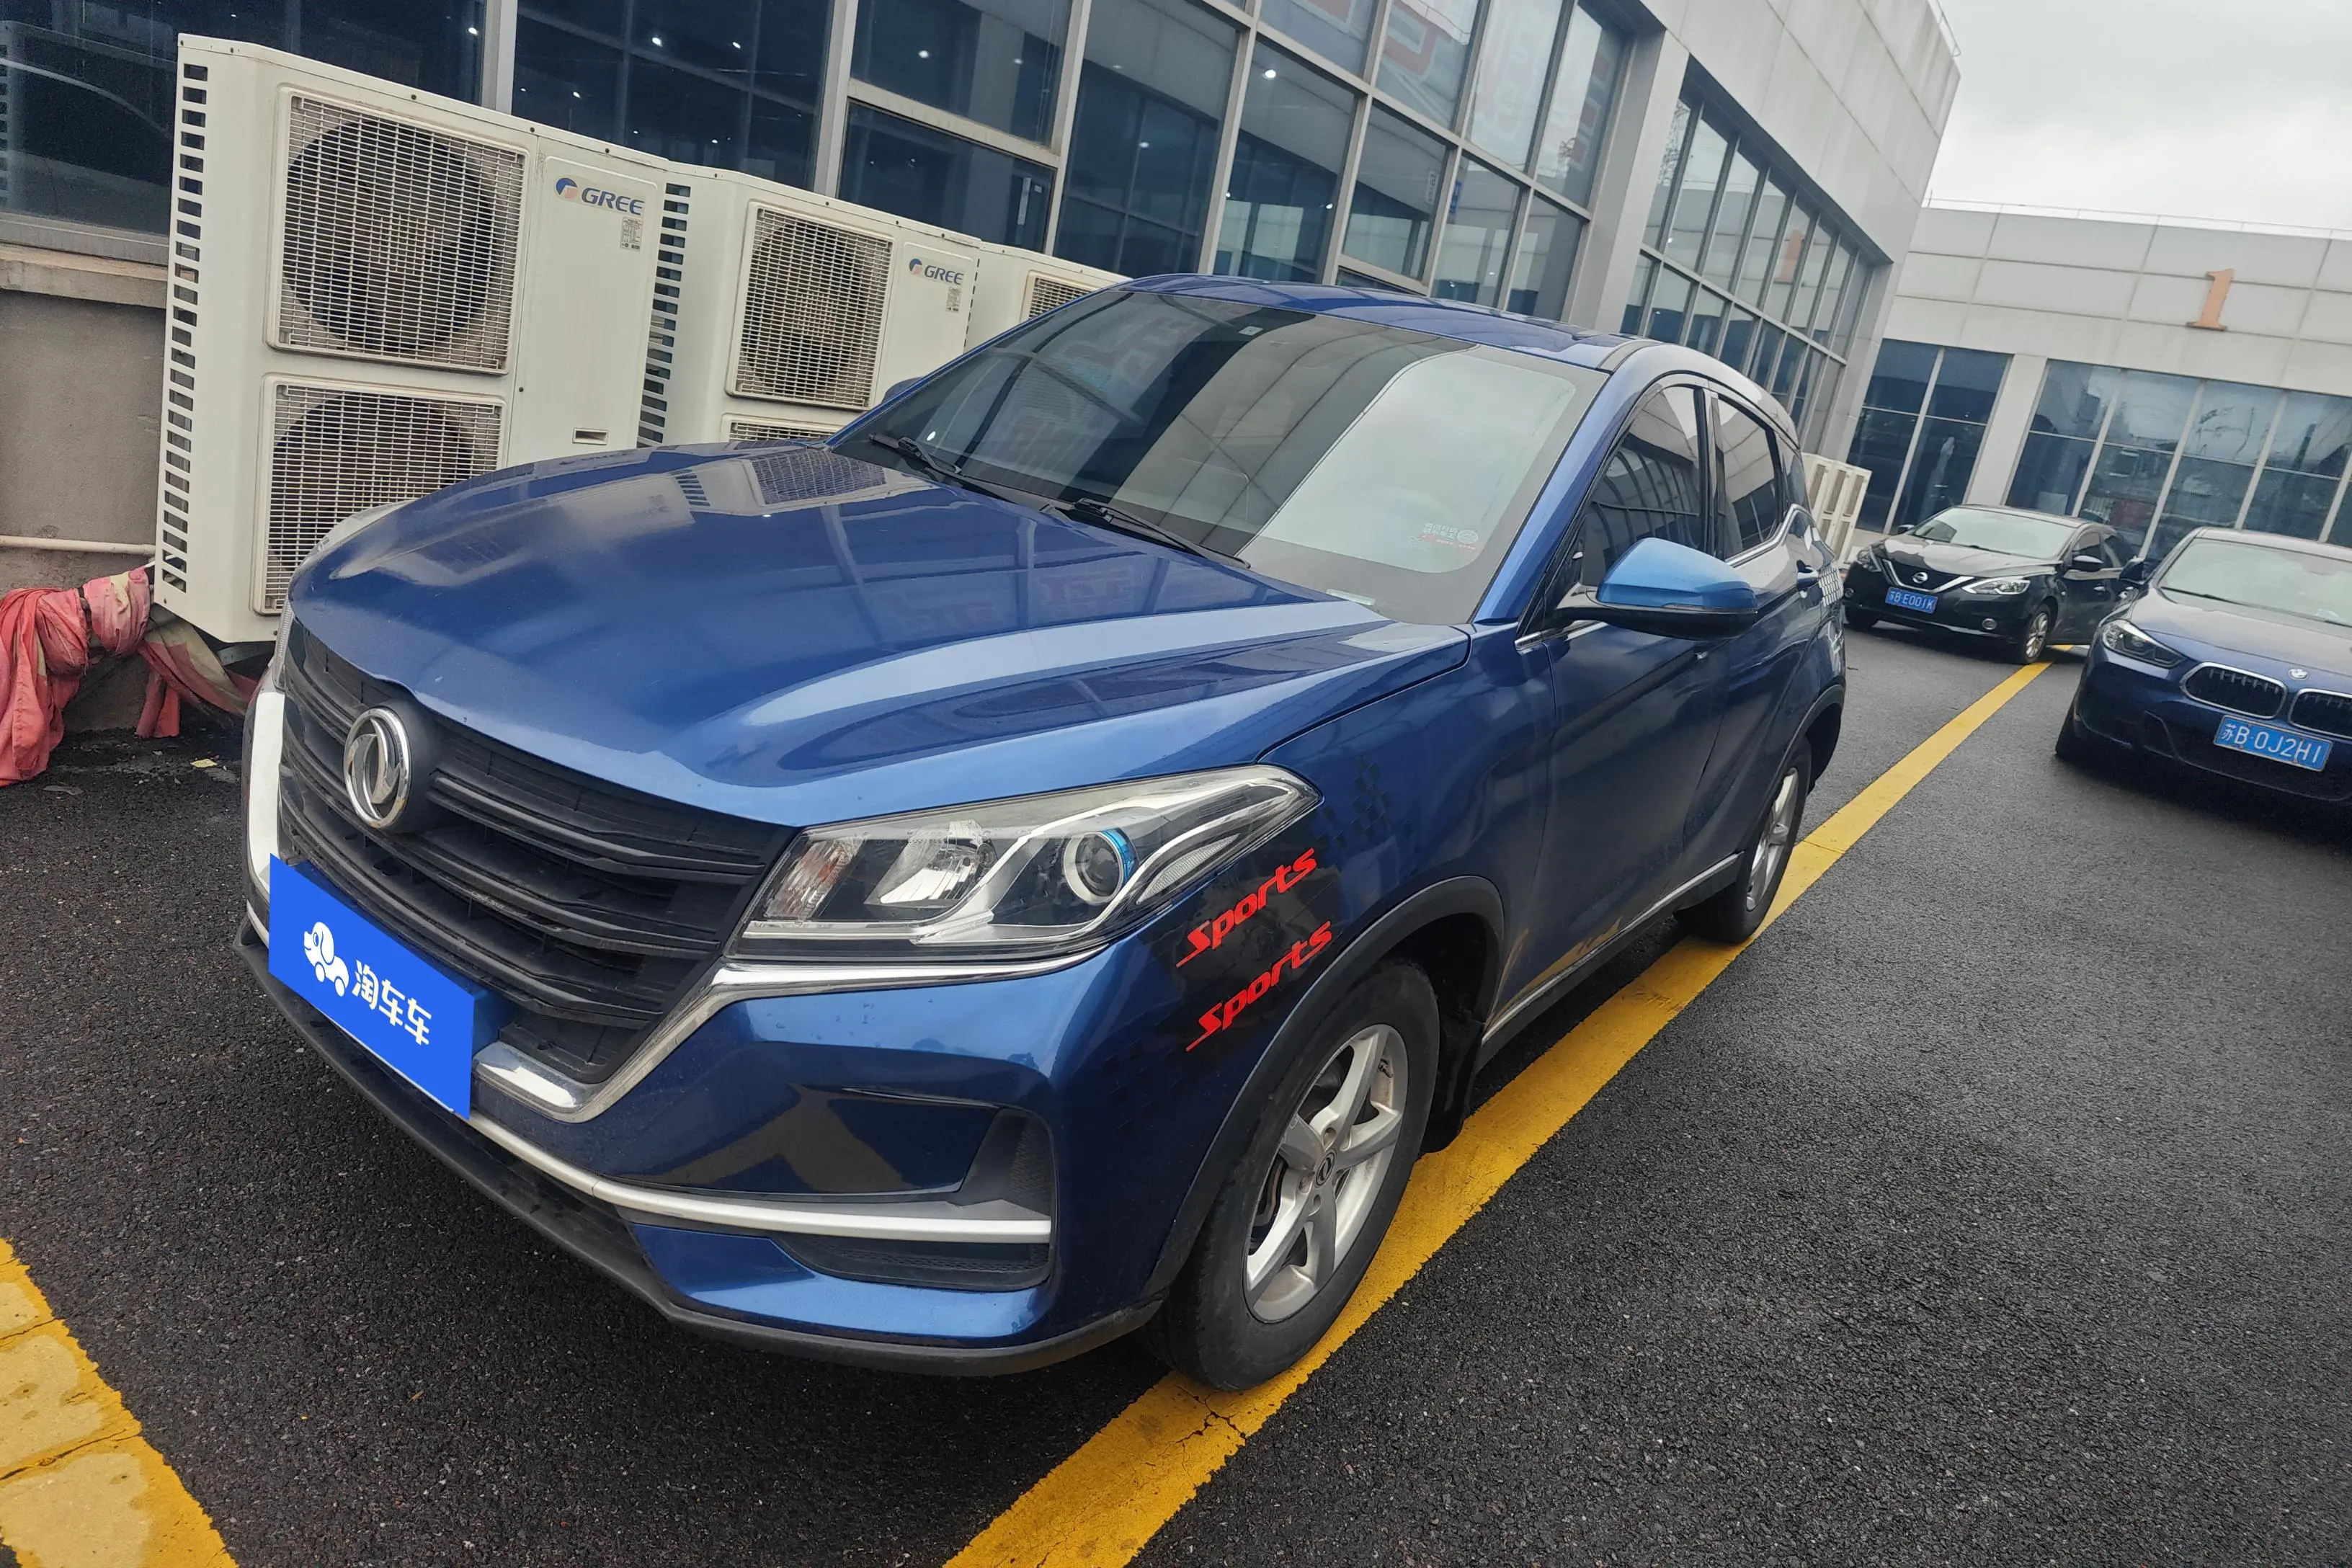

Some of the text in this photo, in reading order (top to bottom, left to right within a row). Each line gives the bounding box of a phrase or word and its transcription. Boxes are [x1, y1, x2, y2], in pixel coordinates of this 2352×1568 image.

[582, 187, 646, 215] GREE
[924, 264, 964, 285] GREE
[2186, 268, 2235, 331] 1
[1176, 847, 1317, 968] Sports
[1185, 921, 1332, 1052] Sports
